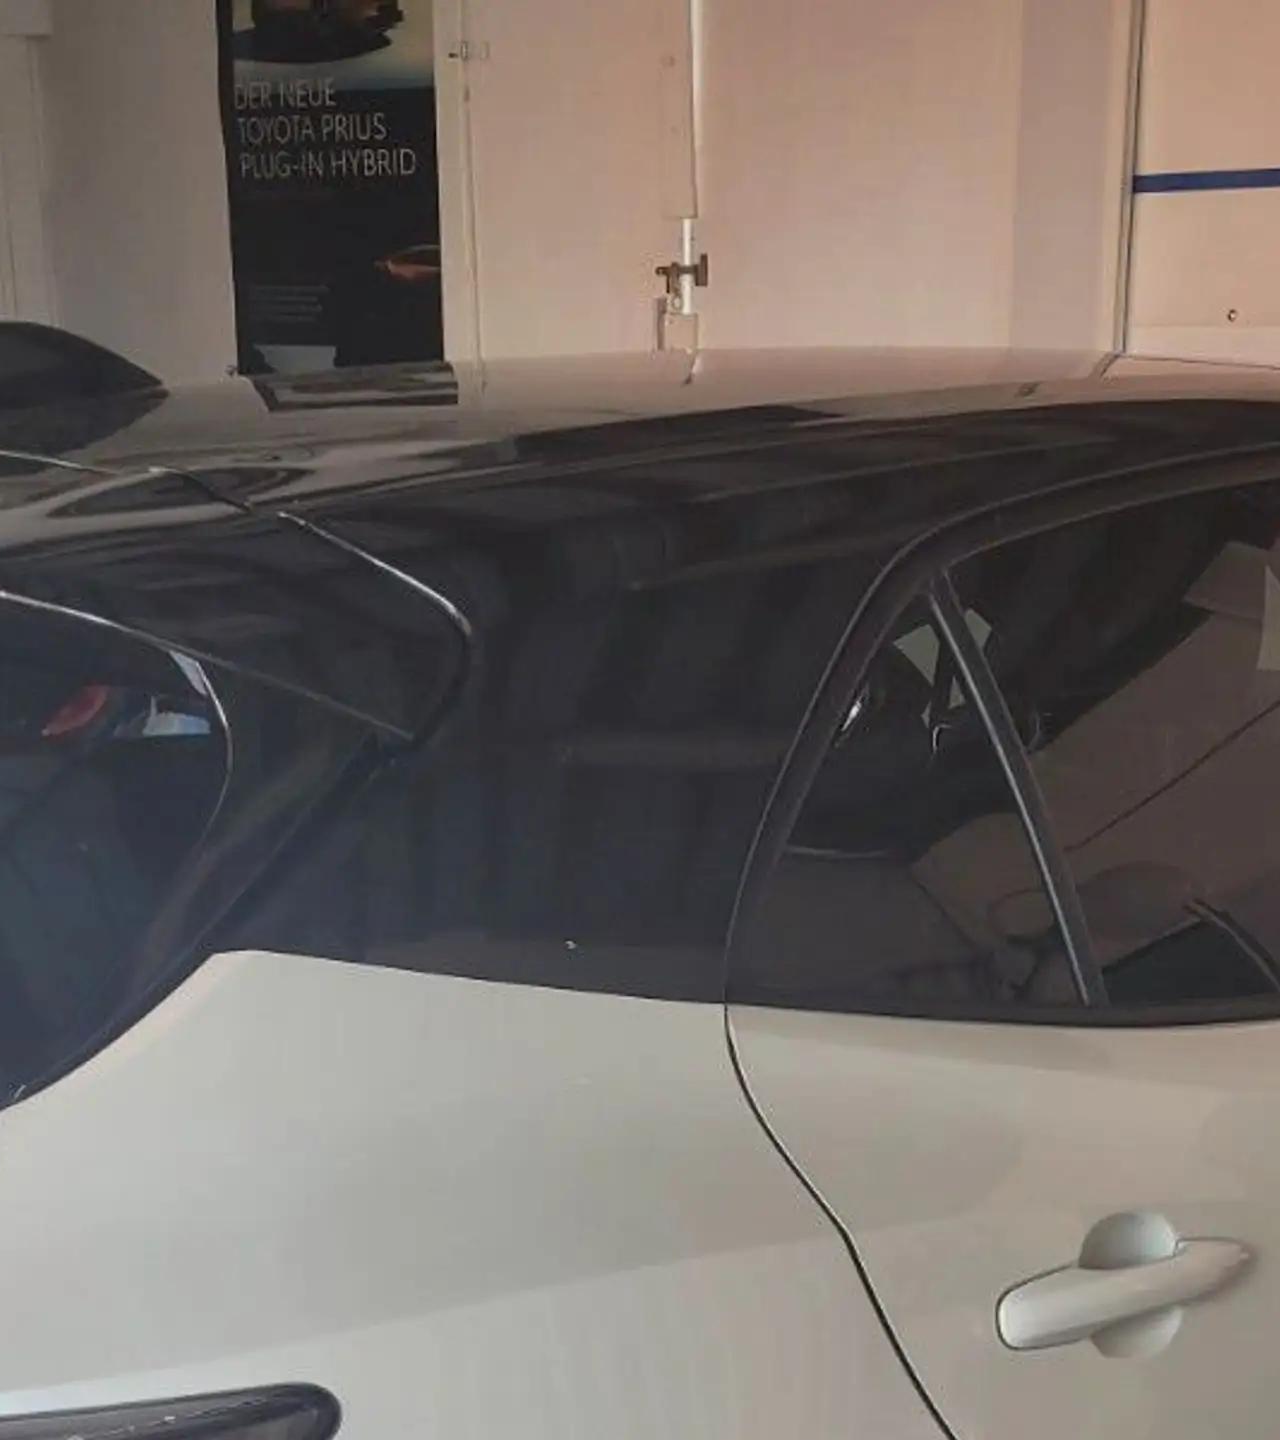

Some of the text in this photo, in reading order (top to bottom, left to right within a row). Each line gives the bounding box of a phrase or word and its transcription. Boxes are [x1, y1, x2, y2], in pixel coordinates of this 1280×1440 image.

[234, 76, 338, 110] DER NEUE
[237, 112, 388, 145] TOYOTA PRIUS
[239, 148, 417, 179] PLUG-IN HYBRID
